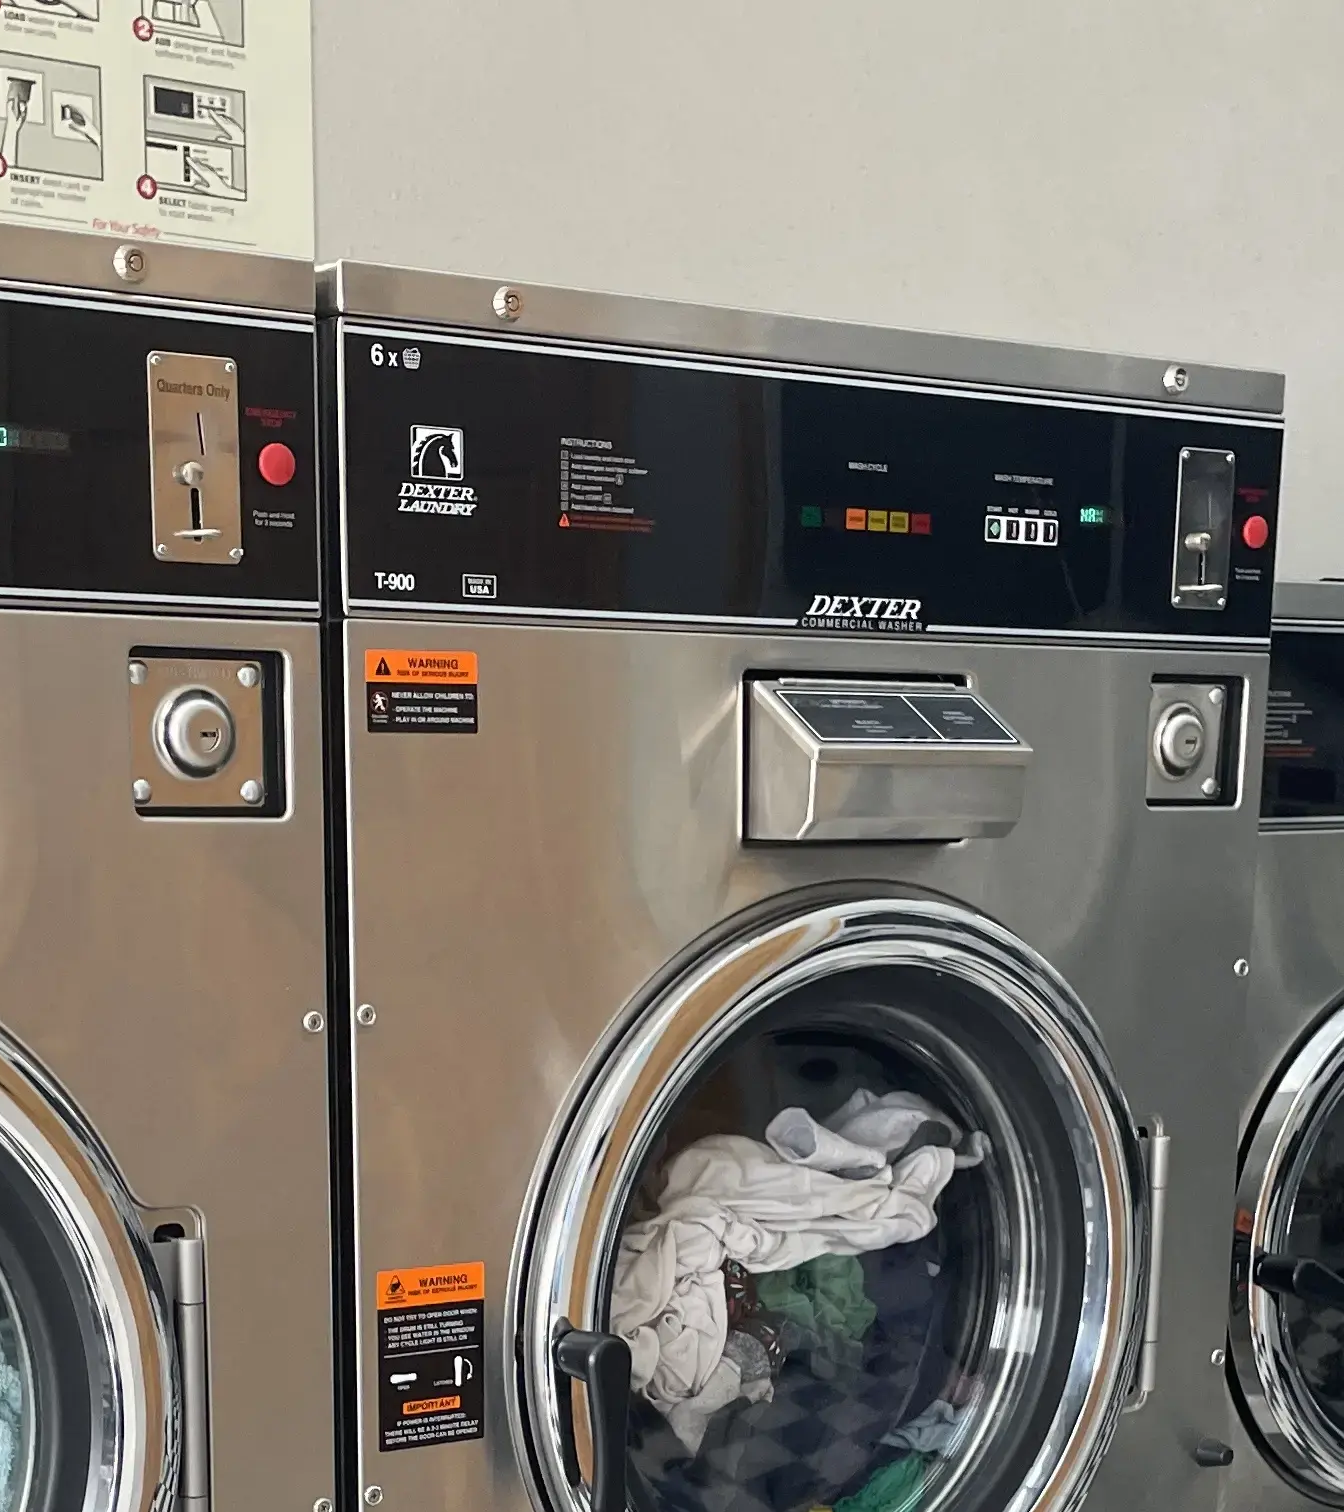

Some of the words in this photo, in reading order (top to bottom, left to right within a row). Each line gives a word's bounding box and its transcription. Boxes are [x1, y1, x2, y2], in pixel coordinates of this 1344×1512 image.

[159, 196, 187, 207] SELECT
[370, 343, 384, 366] 6
[388, 351, 398, 367] x
[156, 378, 203, 397] Quarters
[206, 383, 231, 401] Only
[398, 482, 475, 501] DEXTER
[398, 499, 477, 516] LAUNDRY
[374, 571, 415, 591] T-900
[469, 585, 490, 594] USA
[805, 594, 922, 620] DEXTER
[801, 617, 874, 631] COMMERCIAL
[878, 620, 923, 632] WASHER
[407, 658, 459, 670] WARNING
[419, 1274, 468, 1287] WARNING
[407, 1399, 456, 1412] IMPORTANT
